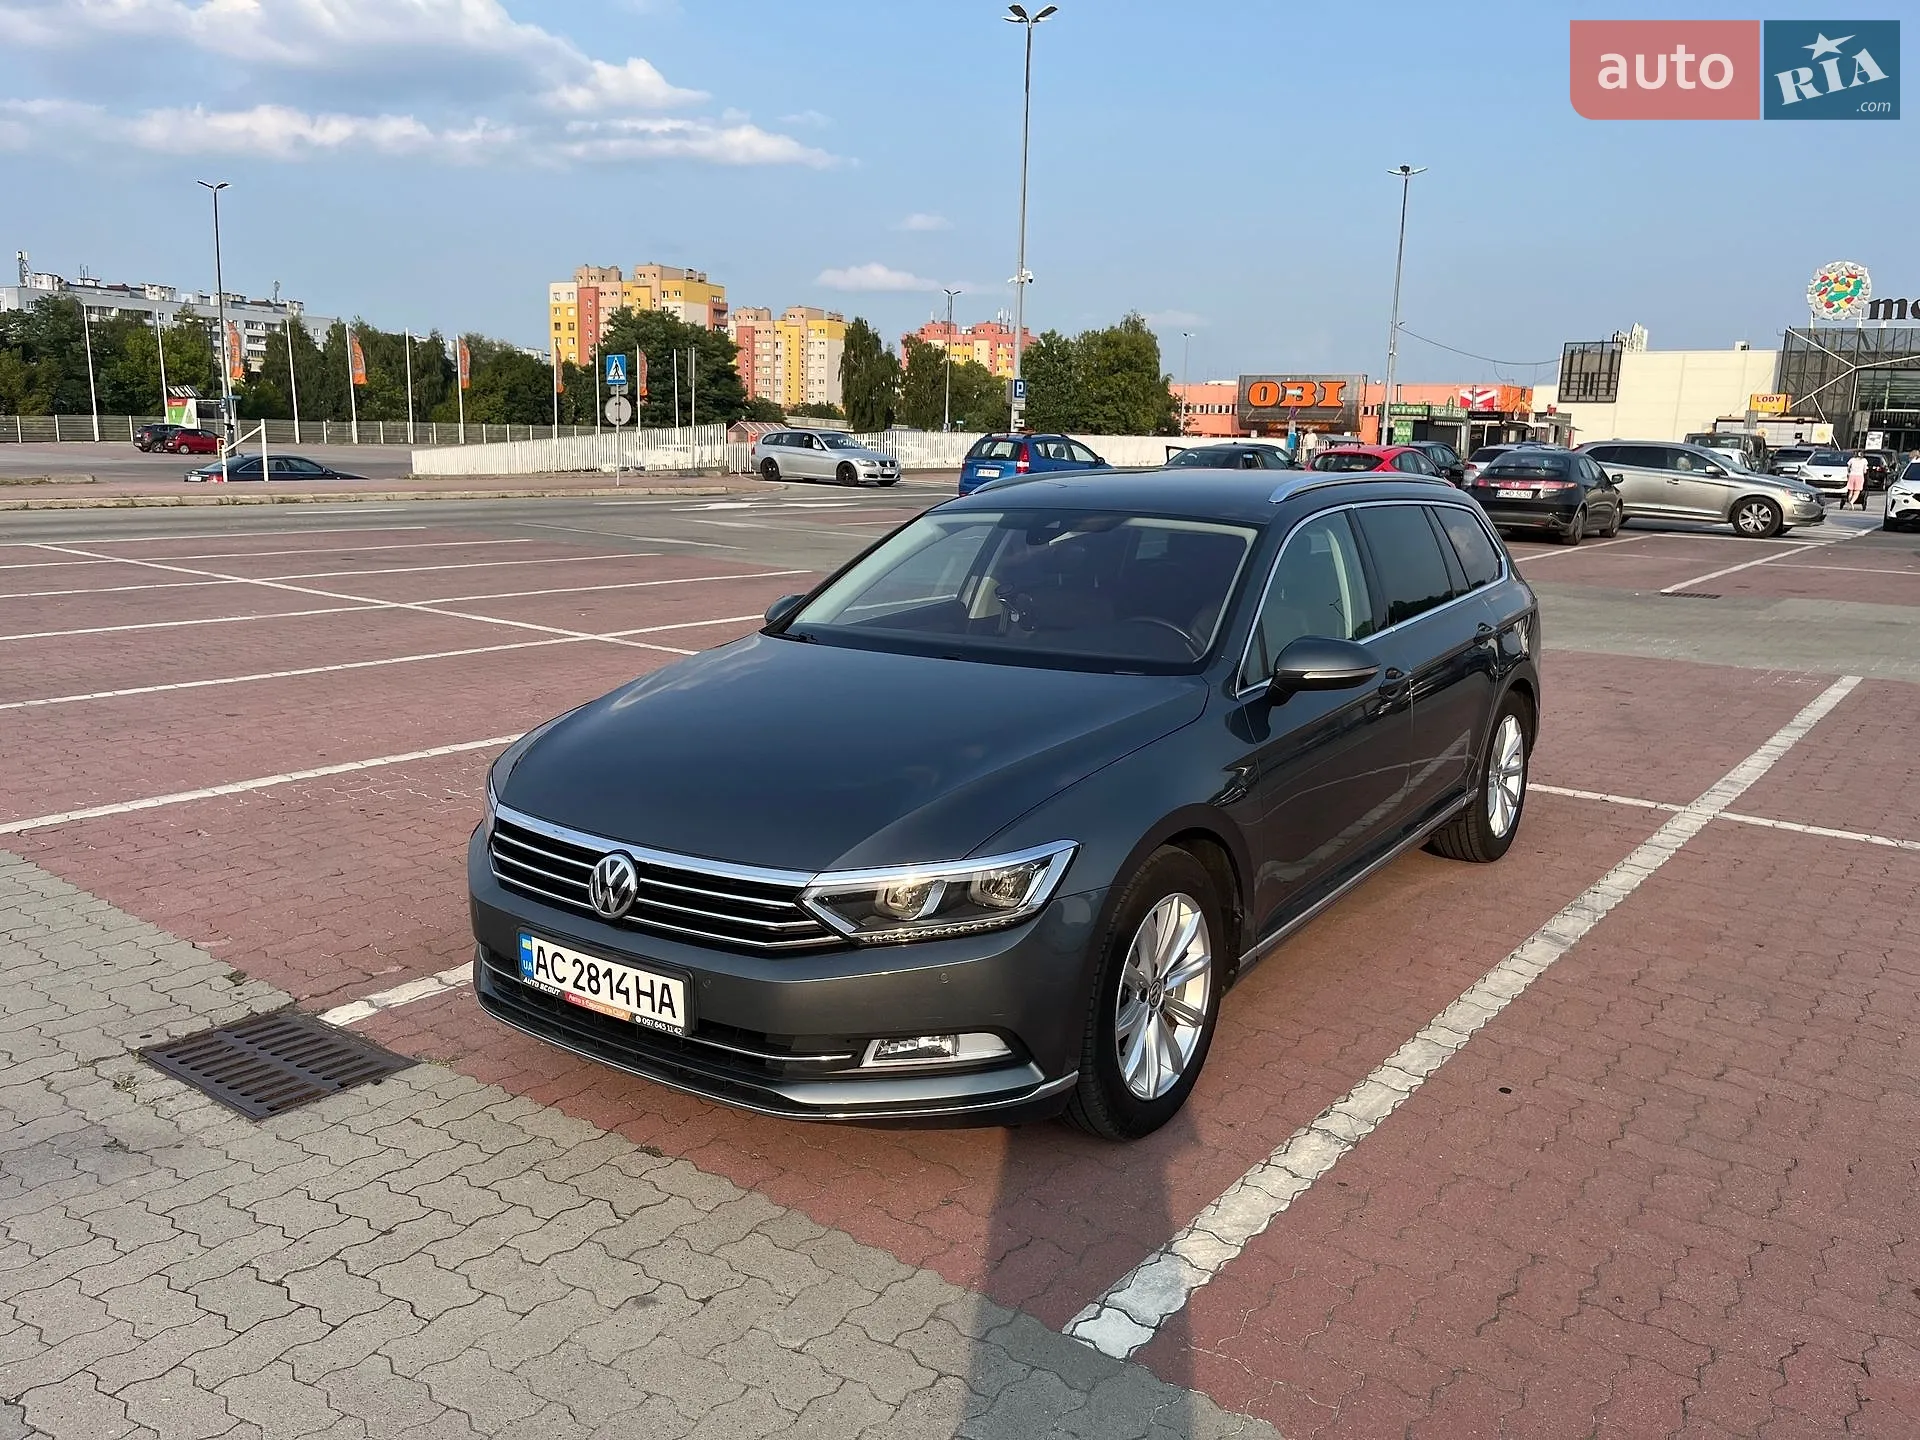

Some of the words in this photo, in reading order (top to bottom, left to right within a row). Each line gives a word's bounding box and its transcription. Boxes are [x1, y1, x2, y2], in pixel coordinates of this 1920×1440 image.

[1016, 381, 1024, 396] P
[1248, 381, 1346, 408] OBI
[523, 959, 533, 972] UA
[523, 977, 540, 988] AUTO
[540, 984, 561, 996] SCOUT
[535, 945, 567, 984] AC
[572, 958, 631, 1005] 2814
[635, 975, 677, 1018] HA
[642, 1017, 654, 1027] 097
[667, 1025, 674, 1033] 11
[674, 1028, 683, 1036] 42
